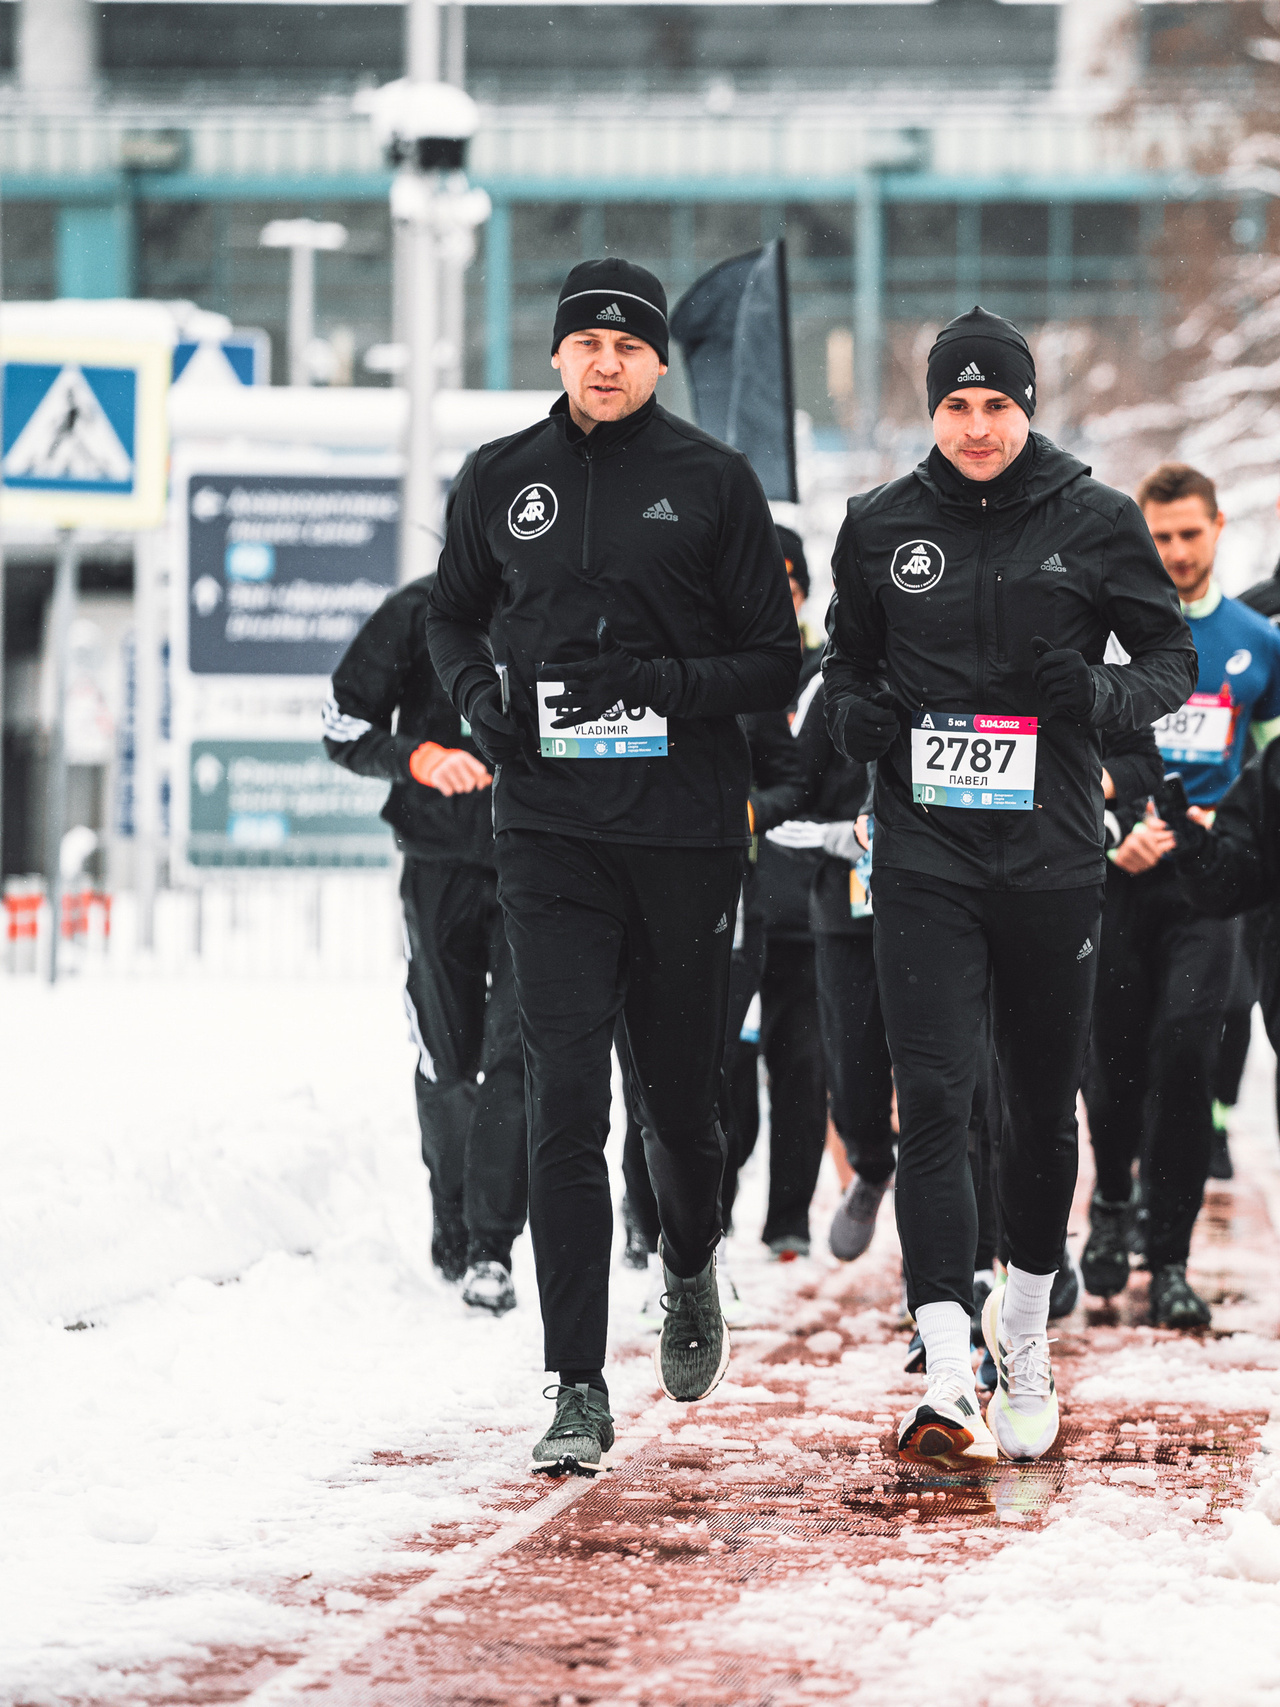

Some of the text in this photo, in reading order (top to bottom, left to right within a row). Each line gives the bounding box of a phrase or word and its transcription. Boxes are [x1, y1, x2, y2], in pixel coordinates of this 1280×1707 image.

[596, 313, 626, 323] adidas
[957, 373, 986, 383] adidas
[642, 510, 679, 522] adidas
[1040, 562, 1067, 573] adidas
[948, 717, 954, 726] 5
[980, 719, 1020, 729] 3.04.2022
[573, 725, 629, 736] VLADIMIR
[555, 739, 567, 756] D
[926, 736, 1017, 774] 2787
[949, 775, 988, 787] ПАВЕЛ
[925, 785, 936, 803] D
